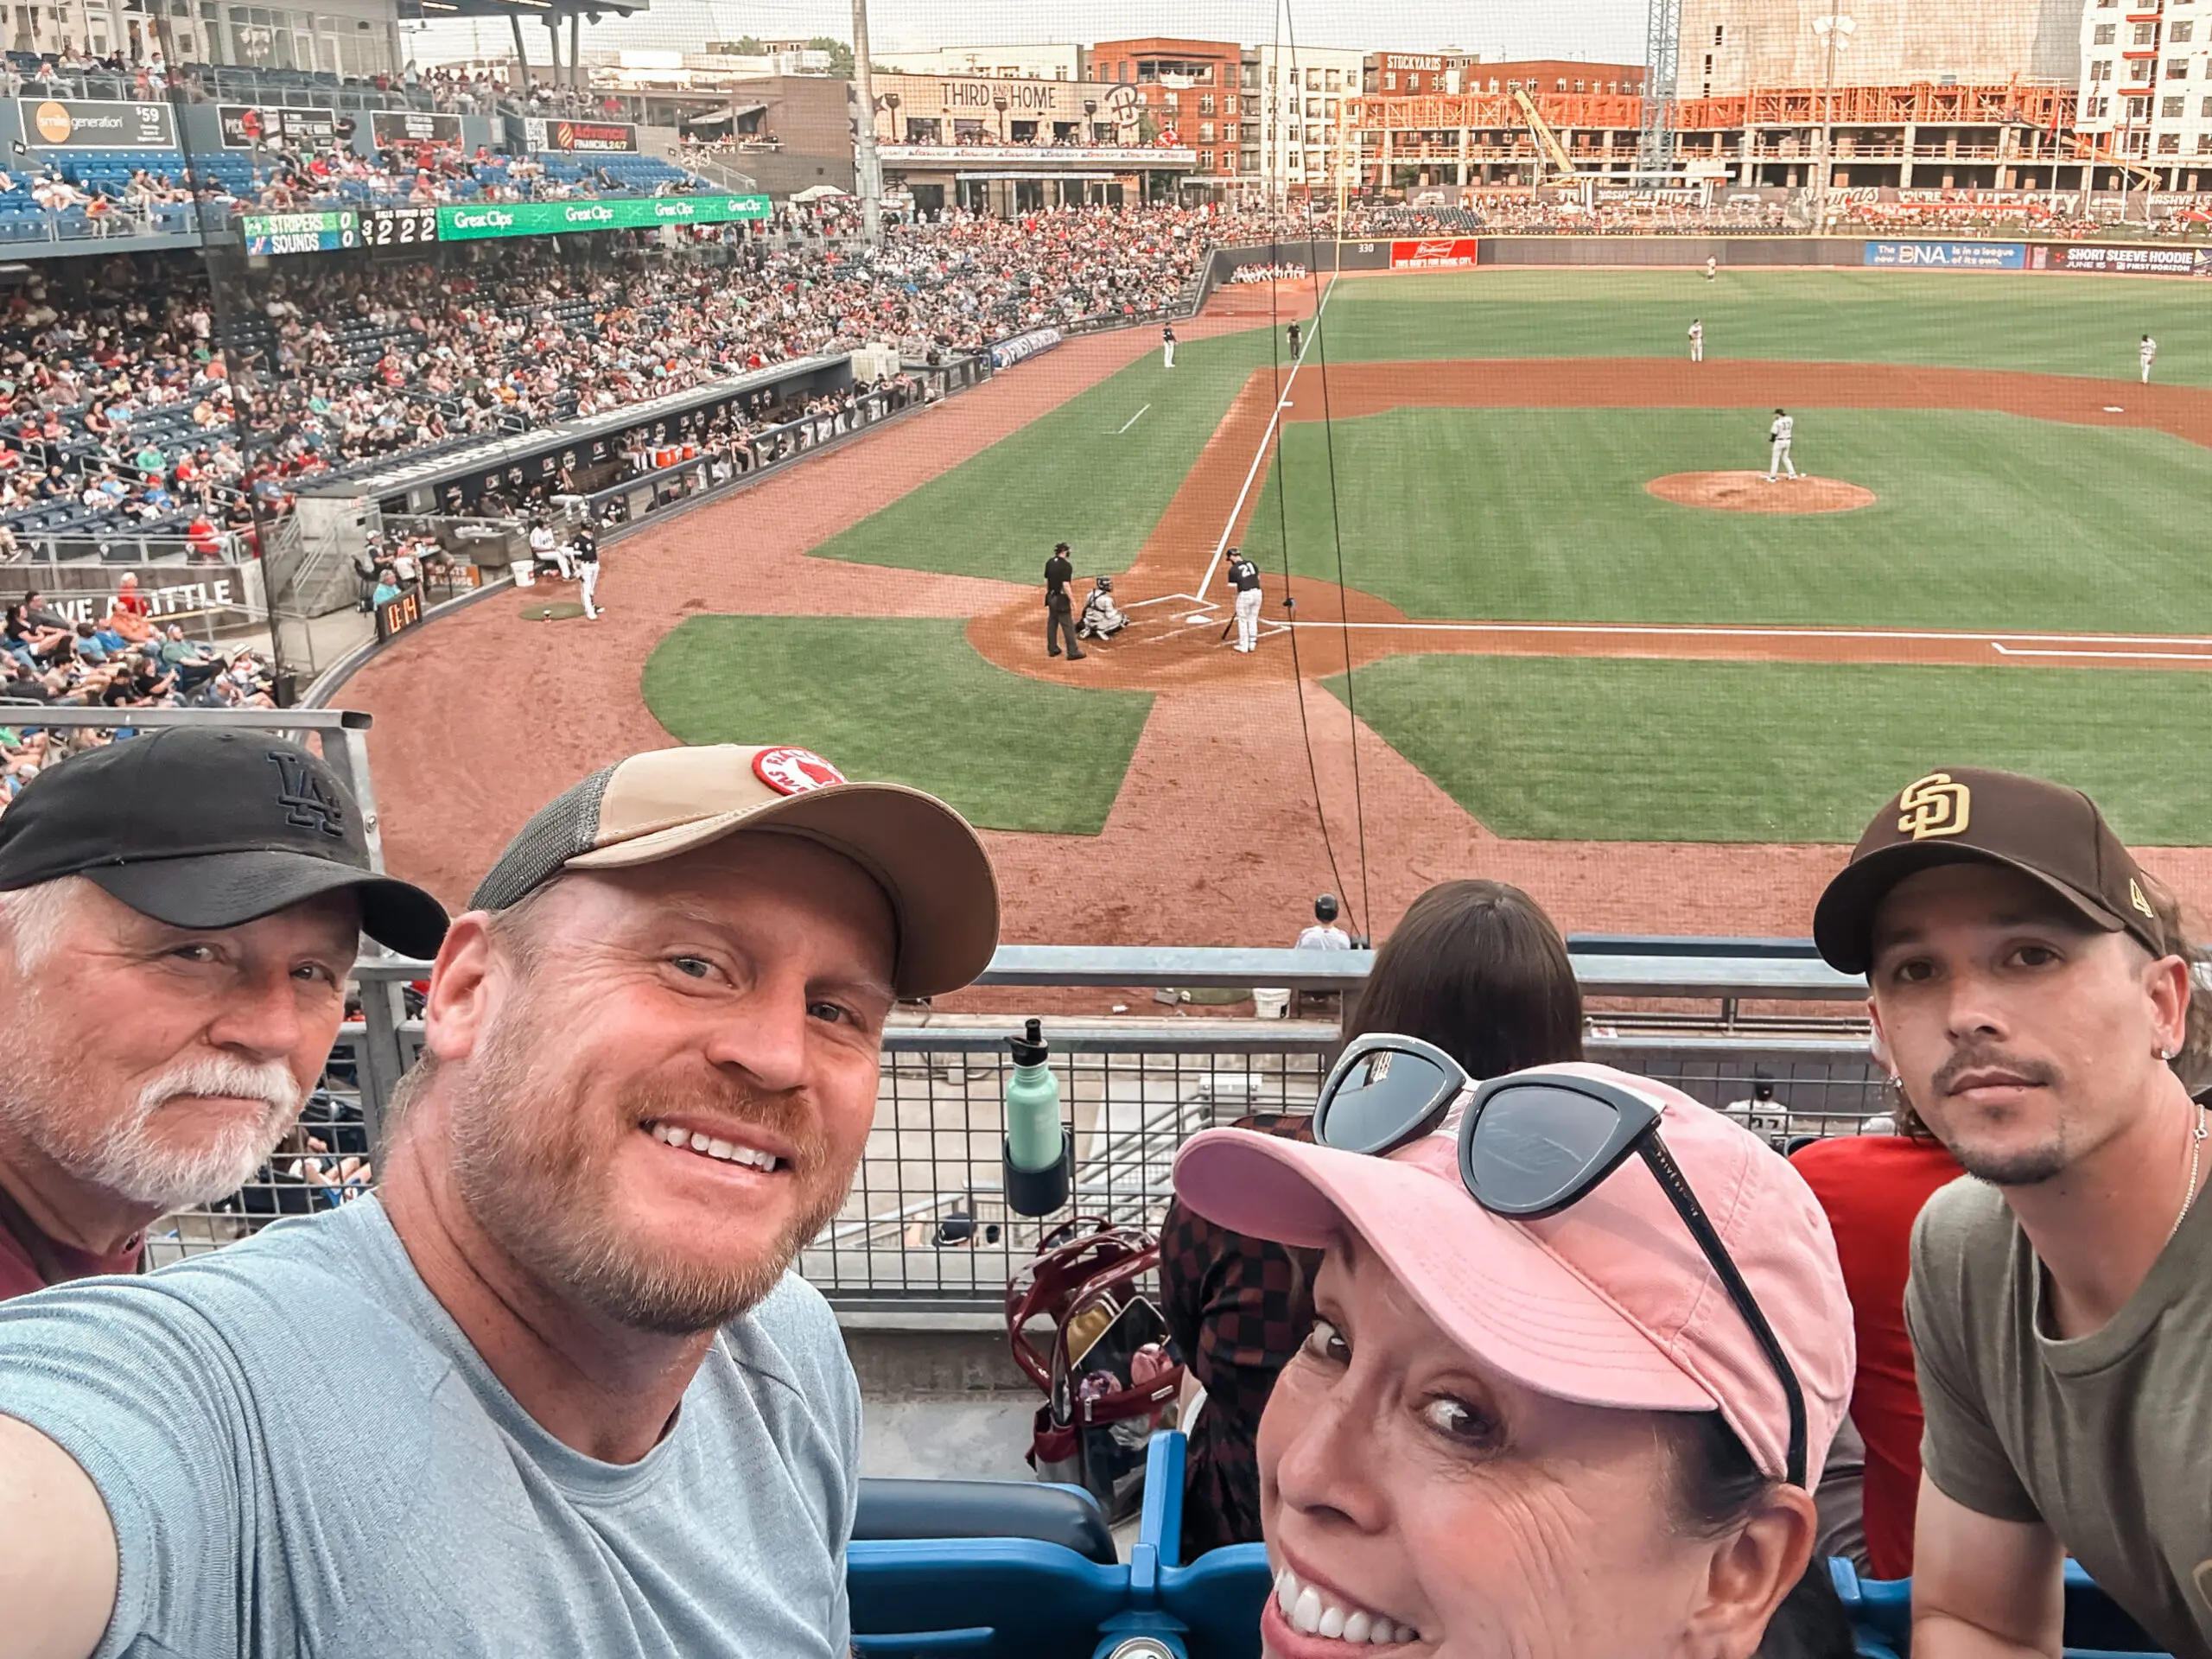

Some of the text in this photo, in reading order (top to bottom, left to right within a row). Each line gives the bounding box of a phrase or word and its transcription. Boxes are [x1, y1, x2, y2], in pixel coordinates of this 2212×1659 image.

[1387, 55, 1441, 71] STOCKYARDS
[941, 83, 988, 105] THIRD
[1011, 86, 1056, 108] HOME
[39, 115, 68, 127] smile
[566, 206, 613, 222] Great Clips
[655, 200, 695, 217] Great Clips
[728, 199, 763, 213] Great Clips
[270, 214, 323, 233] STRIPERS
[340, 213, 351, 228] 0
[454, 211, 513, 229] Great Clips
[342, 231, 353, 247] 0
[362, 217, 435, 245] 3 2 2 2
[272, 233, 320, 254] SOUNDS
[1358, 244, 1375, 253] 330
[1878, 245, 1895, 254] The
[1952, 246, 1961, 255] is
[1963, 246, 1971, 255] in
[1982, 247, 2014, 257] league
[1951, 256, 1961, 264] of
[2067, 248, 2194, 264] SHORT SLEEVE HOODIE
[1238, 562, 1255, 577] 21
[1897, 772, 1971, 841] SD
